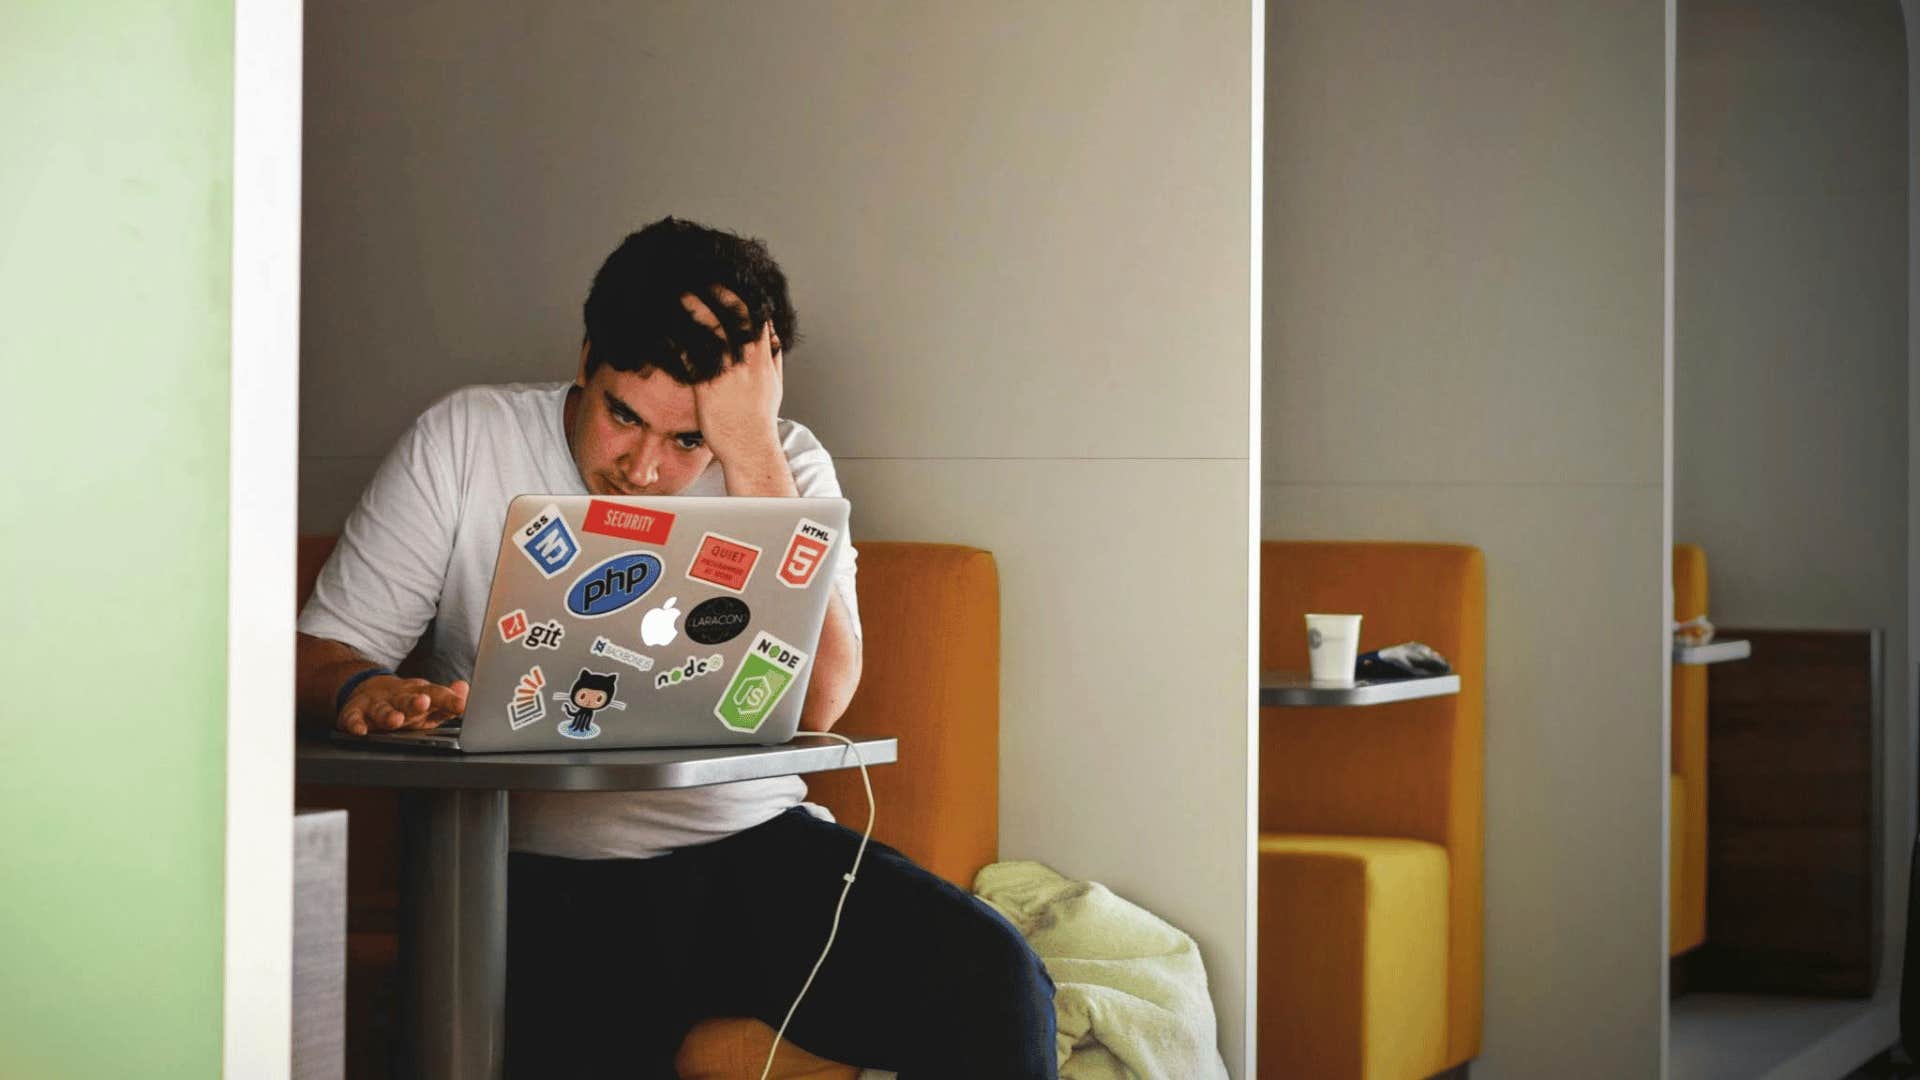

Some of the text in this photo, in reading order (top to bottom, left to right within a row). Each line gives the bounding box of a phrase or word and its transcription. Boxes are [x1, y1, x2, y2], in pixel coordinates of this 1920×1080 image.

[525, 515, 549, 537] CSS
[604, 509, 656, 533] SECURITY
[801, 523, 830, 543] HTML
[535, 528, 570, 565] 3
[711, 545, 747, 564] QUIET
[787, 544, 819, 577] 5
[583, 562, 648, 612] php
[692, 613, 744, 629] LARACON
[525, 622, 563, 648] git
